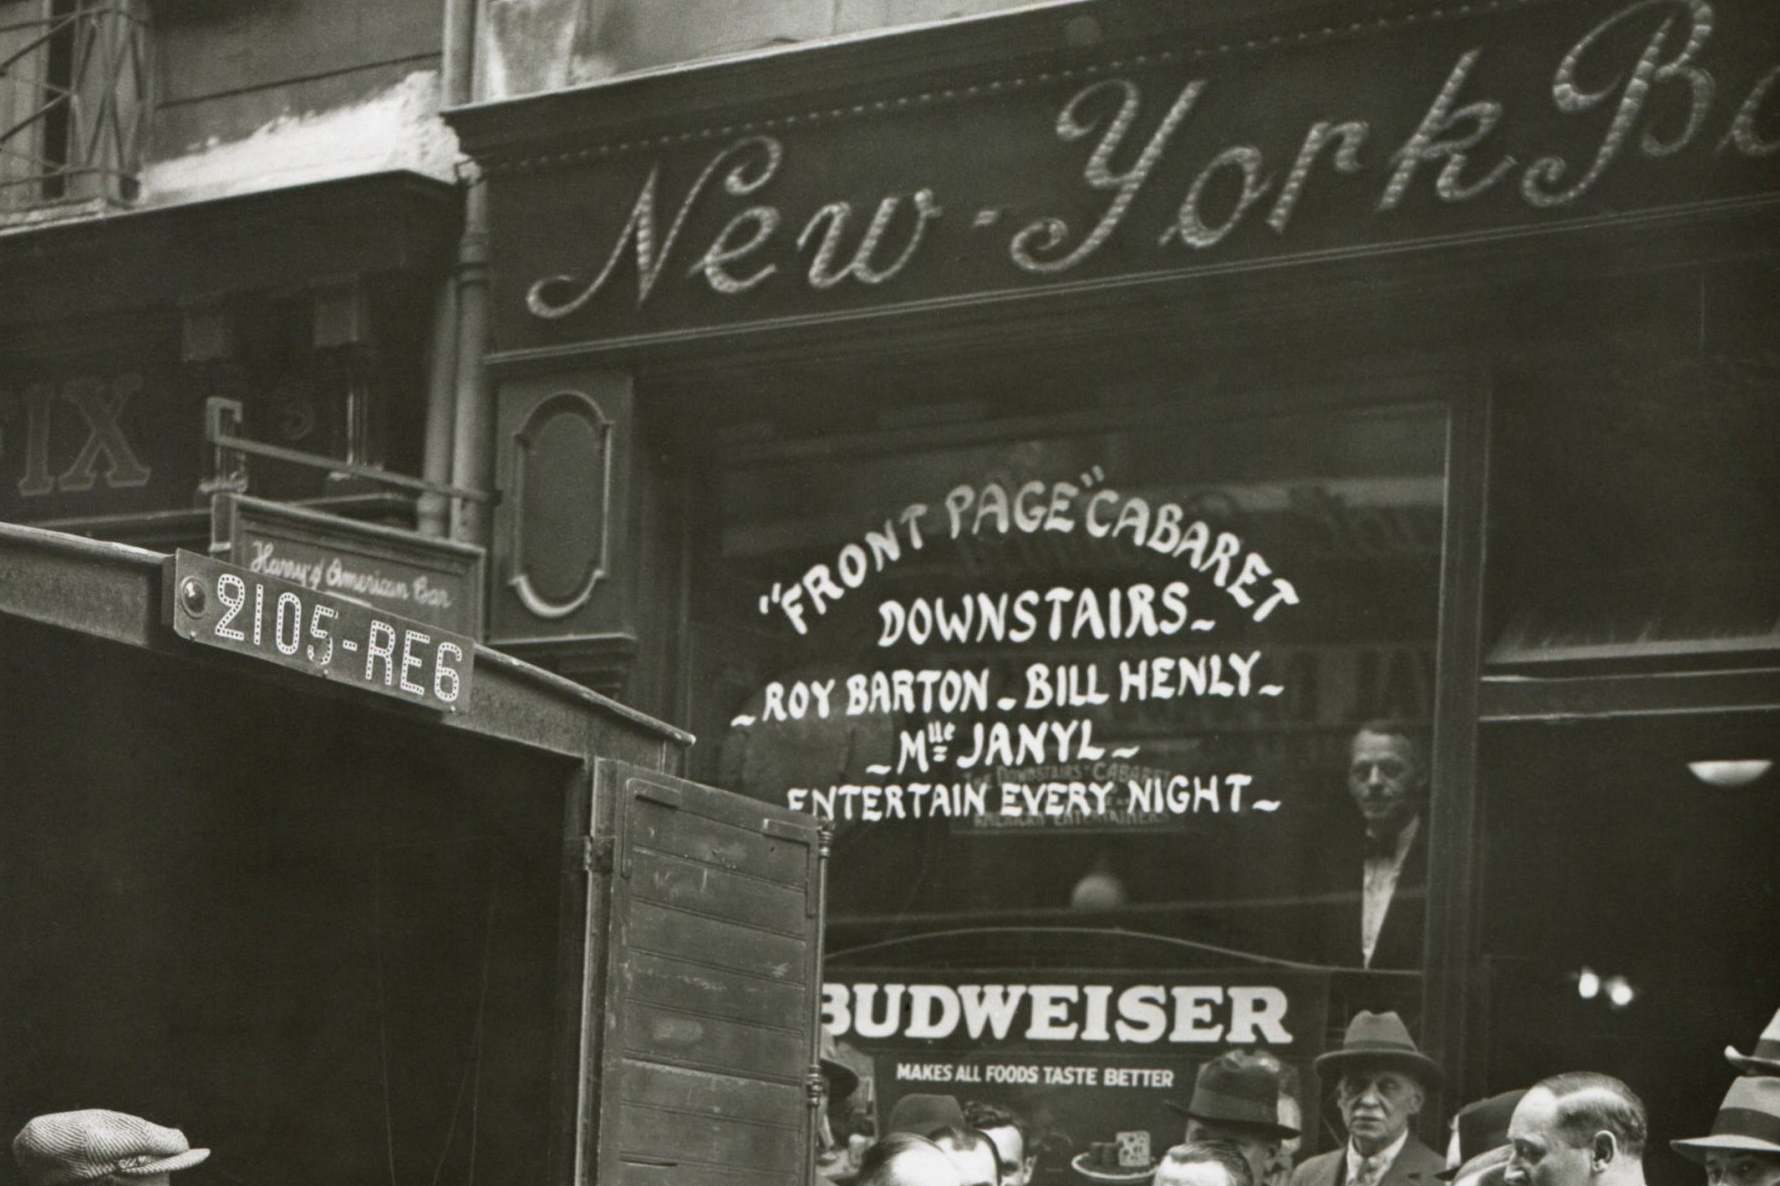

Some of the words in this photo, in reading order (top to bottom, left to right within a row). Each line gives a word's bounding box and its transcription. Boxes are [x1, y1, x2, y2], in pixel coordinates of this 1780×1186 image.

[327, 558, 408, 600] American
[411, 573, 452, 609] Bar
[1086, 489, 1300, 622] CABARET
[214, 573, 464, 703] 2105-RE6
[762, 679, 836, 722] ROY
[845, 669, 989, 716] BARTON
[1025, 663, 1110, 709] BILL
[1119, 650, 1261, 703] HENLY
[956, 719, 1106, 769] JANYL
[787, 782, 988, 822] ENTERTAIN
[1000, 781, 1114, 817] EVERY
[1127, 774, 1252, 814] NIGHT
[820, 983, 1293, 1044] BUDWEISER
[896, 1062, 953, 1082] MAKES
[954, 1064, 982, 1083] ALL
[985, 1064, 1040, 1085] FOODS
[1042, 1066, 1098, 1086] TASTE
[1103, 1067, 1175, 1088] BETTER
